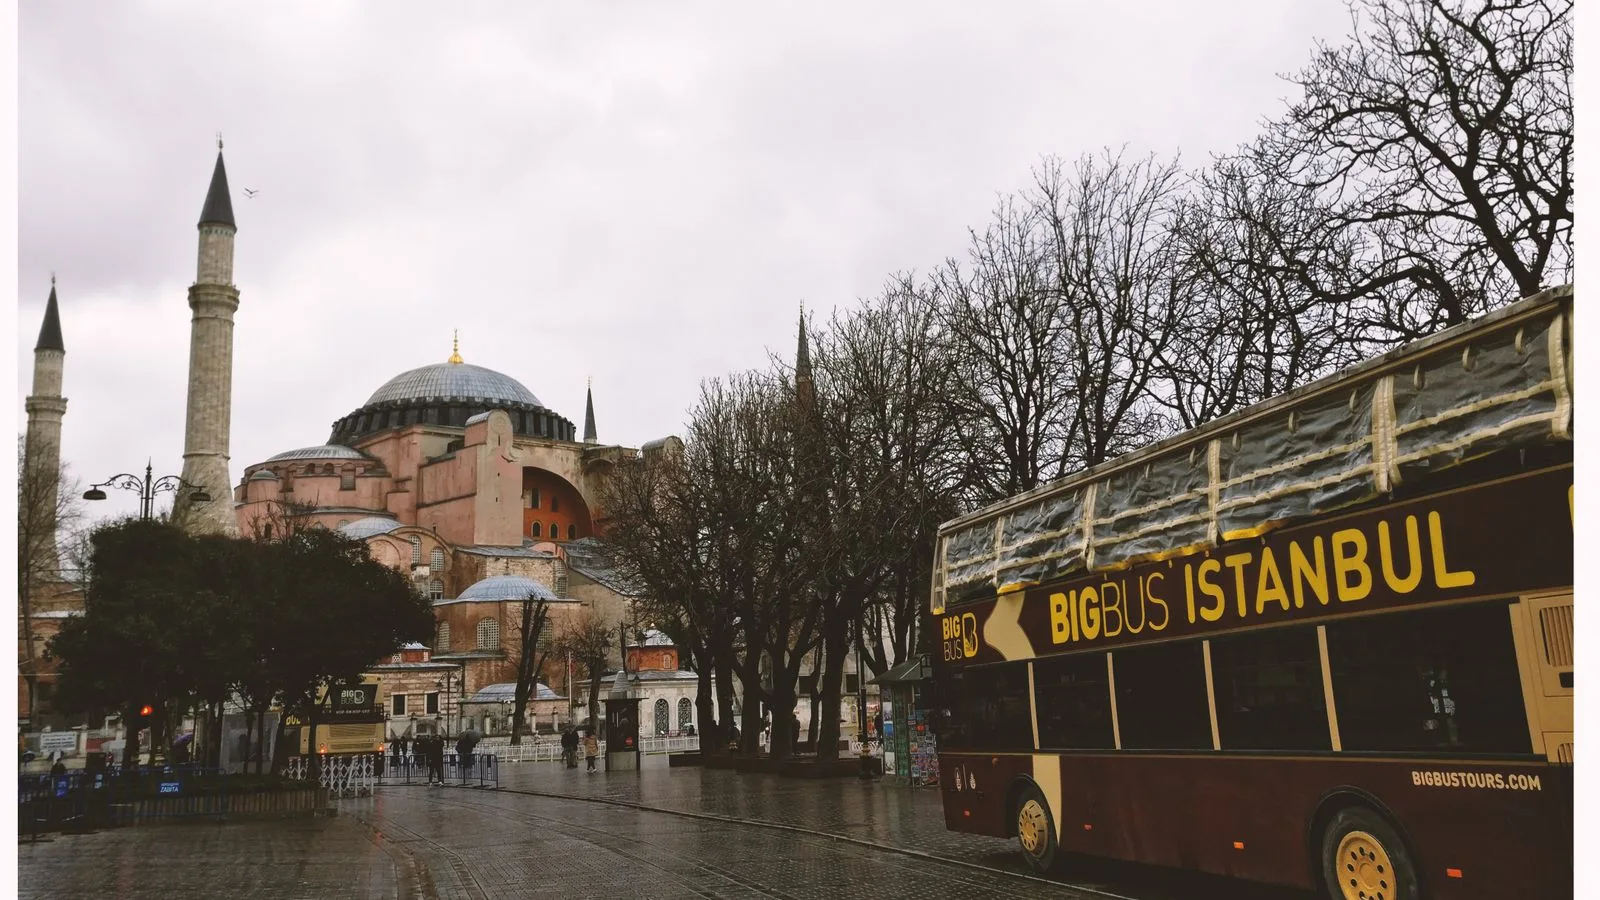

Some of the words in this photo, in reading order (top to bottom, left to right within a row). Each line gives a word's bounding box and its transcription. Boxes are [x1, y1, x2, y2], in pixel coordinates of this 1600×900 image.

[1184, 510, 1476, 624] ISTANBUL
[942, 615, 961, 640] BIG
[943, 639, 963, 661] BUS
[1411, 770, 1542, 791] BIGBUSTOURS.COM
